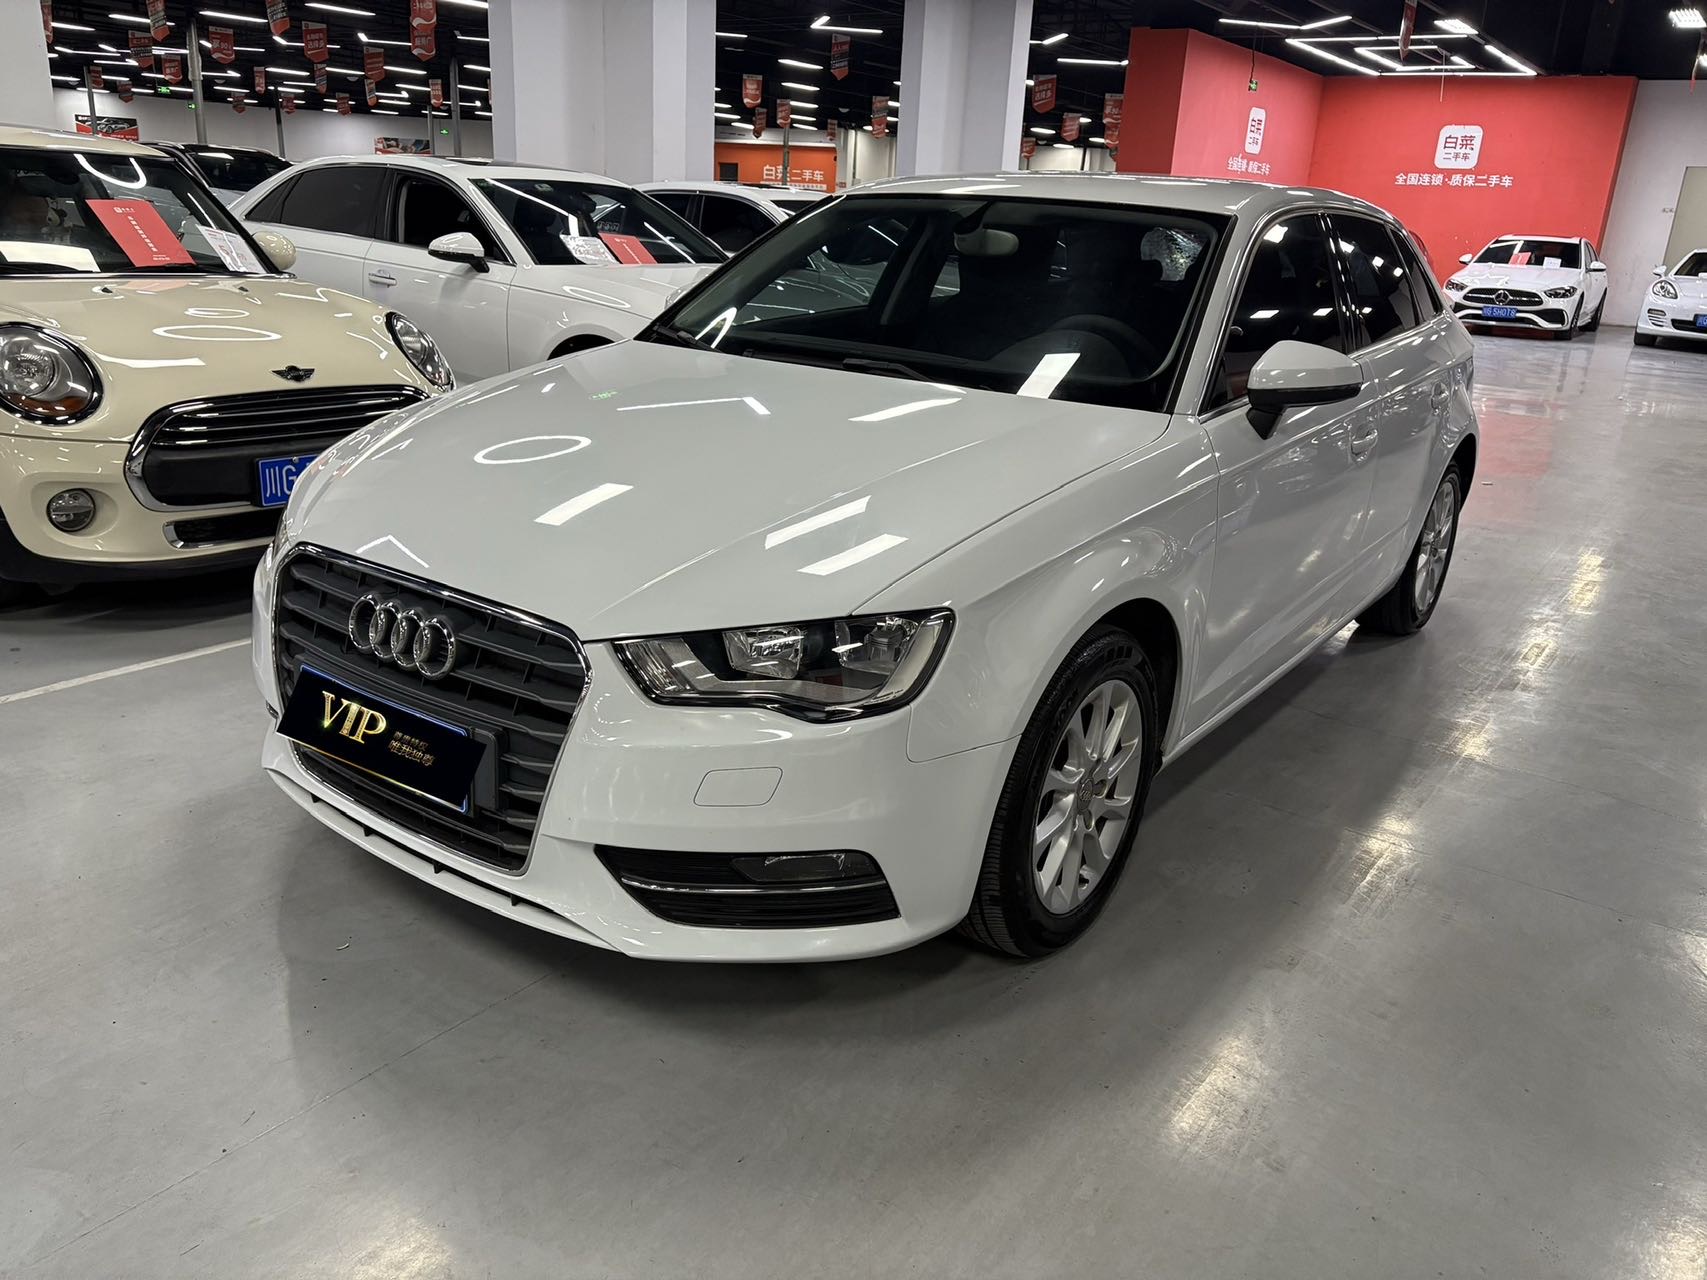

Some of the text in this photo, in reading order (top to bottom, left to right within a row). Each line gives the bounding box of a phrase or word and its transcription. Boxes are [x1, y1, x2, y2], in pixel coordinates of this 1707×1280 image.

[1443, 135, 1476, 151] 白菜
[1443, 151, 1471, 162] 二手车
[266, 463, 309, 498] 川G
[321, 690, 387, 744] VIP
